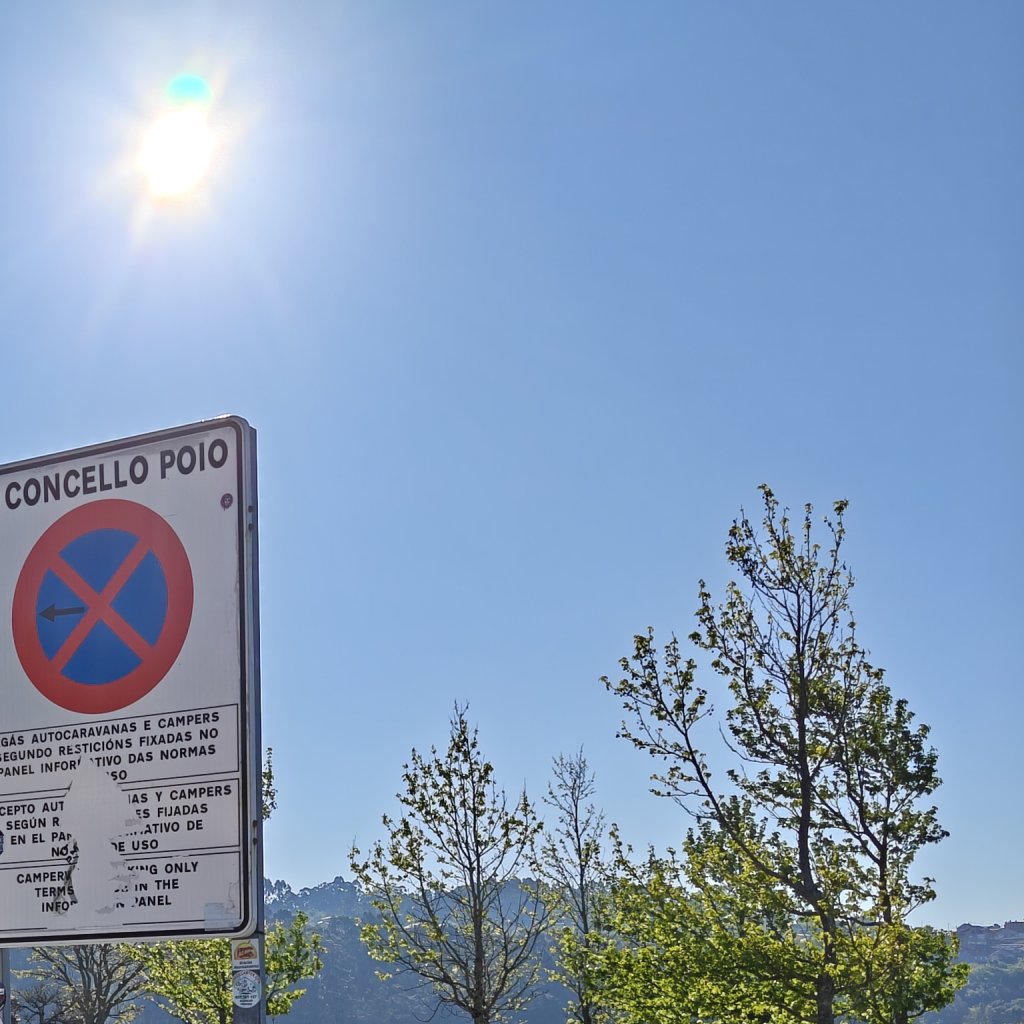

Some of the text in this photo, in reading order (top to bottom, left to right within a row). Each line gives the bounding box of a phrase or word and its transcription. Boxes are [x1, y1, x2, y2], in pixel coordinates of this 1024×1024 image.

[5, 438, 228, 510] CONCELLO POIO
[31, 722, 137, 744] AUTOCARAVANAS
[144, 720, 151, 731] E
[158, 711, 220, 729] CAMPERS
[139, 731, 192, 748] FIXADAS
[199, 728, 219, 741] NO
[128, 751, 153, 764] DAS
[160, 744, 216, 761] NORMAS
[107, 770, 127, 781] SO
[155, 791, 163, 802] Y
[170, 785, 232, 801] CAMPERS
[6, 817, 47, 830] SEGÚN
[157, 803, 208, 818] FIJADAS
[10, 834, 26, 845] EN
[32, 833, 45, 843] EL
[187, 819, 204, 831] DE
[132, 839, 159, 851] USO
[165, 861, 199, 874] ONLY
[34, 885, 74, 898] TERMS
[155, 878, 179, 890] THE
